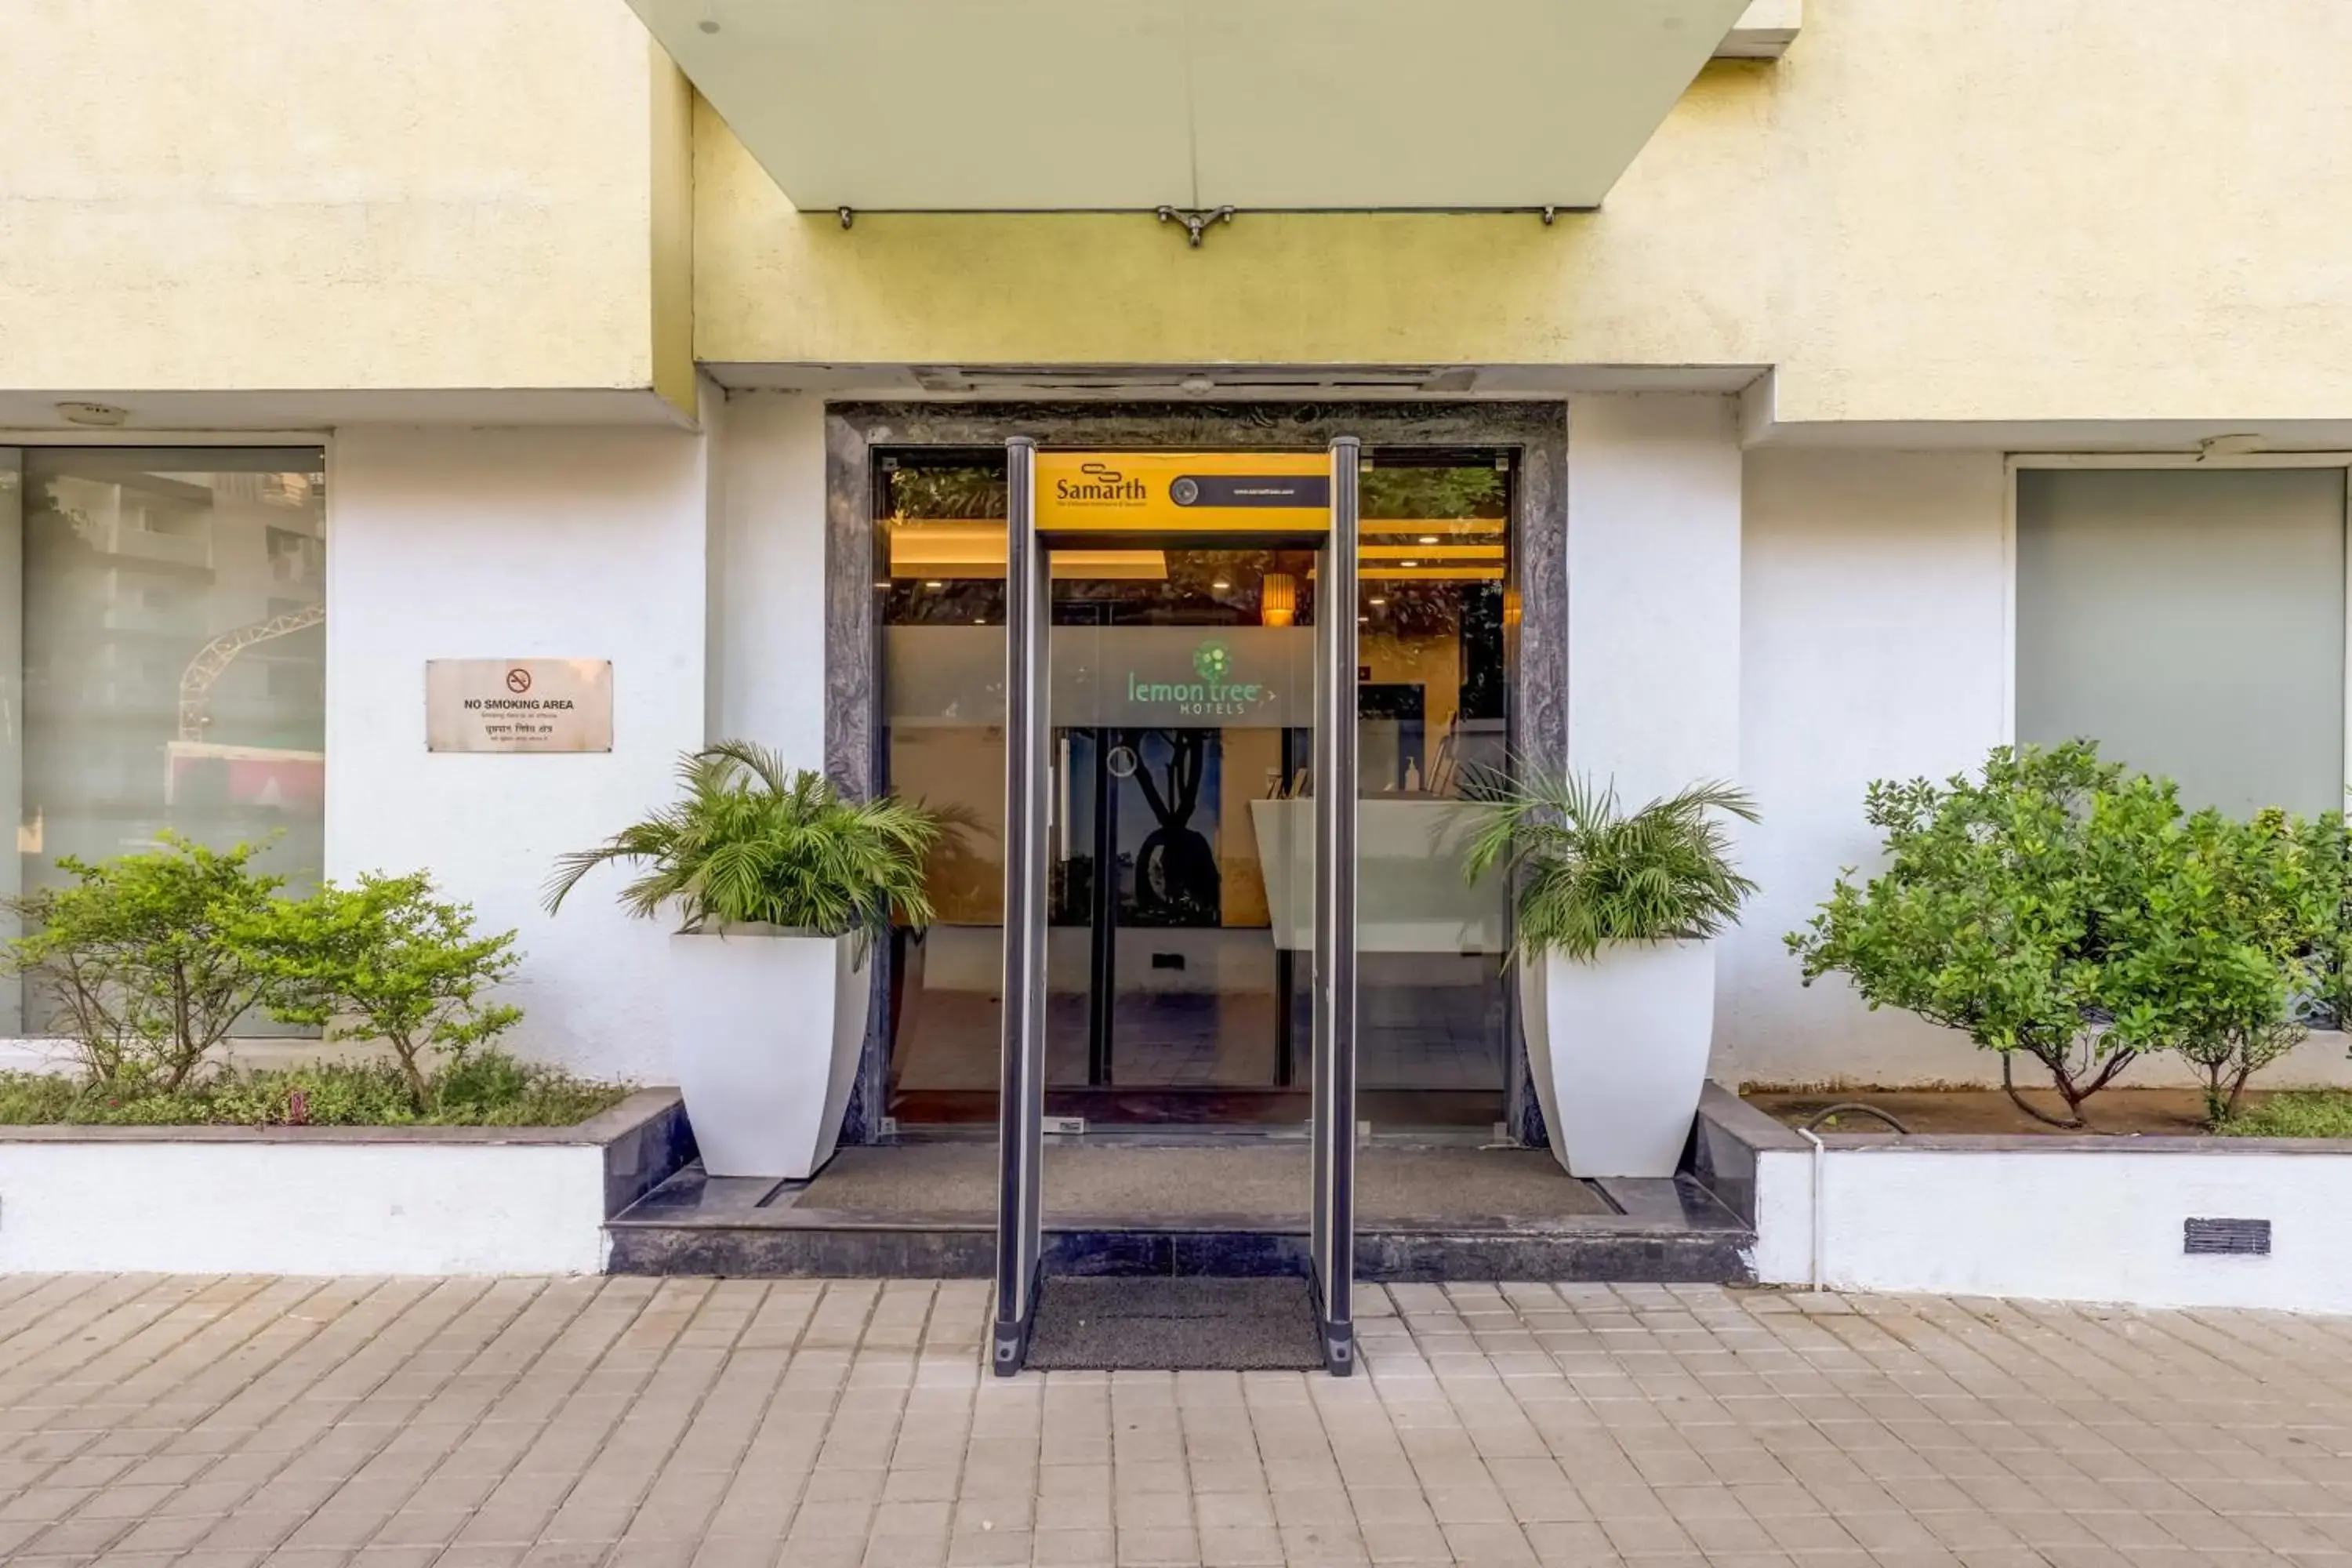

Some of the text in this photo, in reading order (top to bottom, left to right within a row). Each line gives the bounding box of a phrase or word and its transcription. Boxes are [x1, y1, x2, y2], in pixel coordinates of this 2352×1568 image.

[1056, 477, 1146, 499] Samarth
[1127, 670, 1259, 702] lemon tree
[464, 699, 574, 710] NO SMOKING AREA
[1179, 703, 1245, 715] HOTELS
